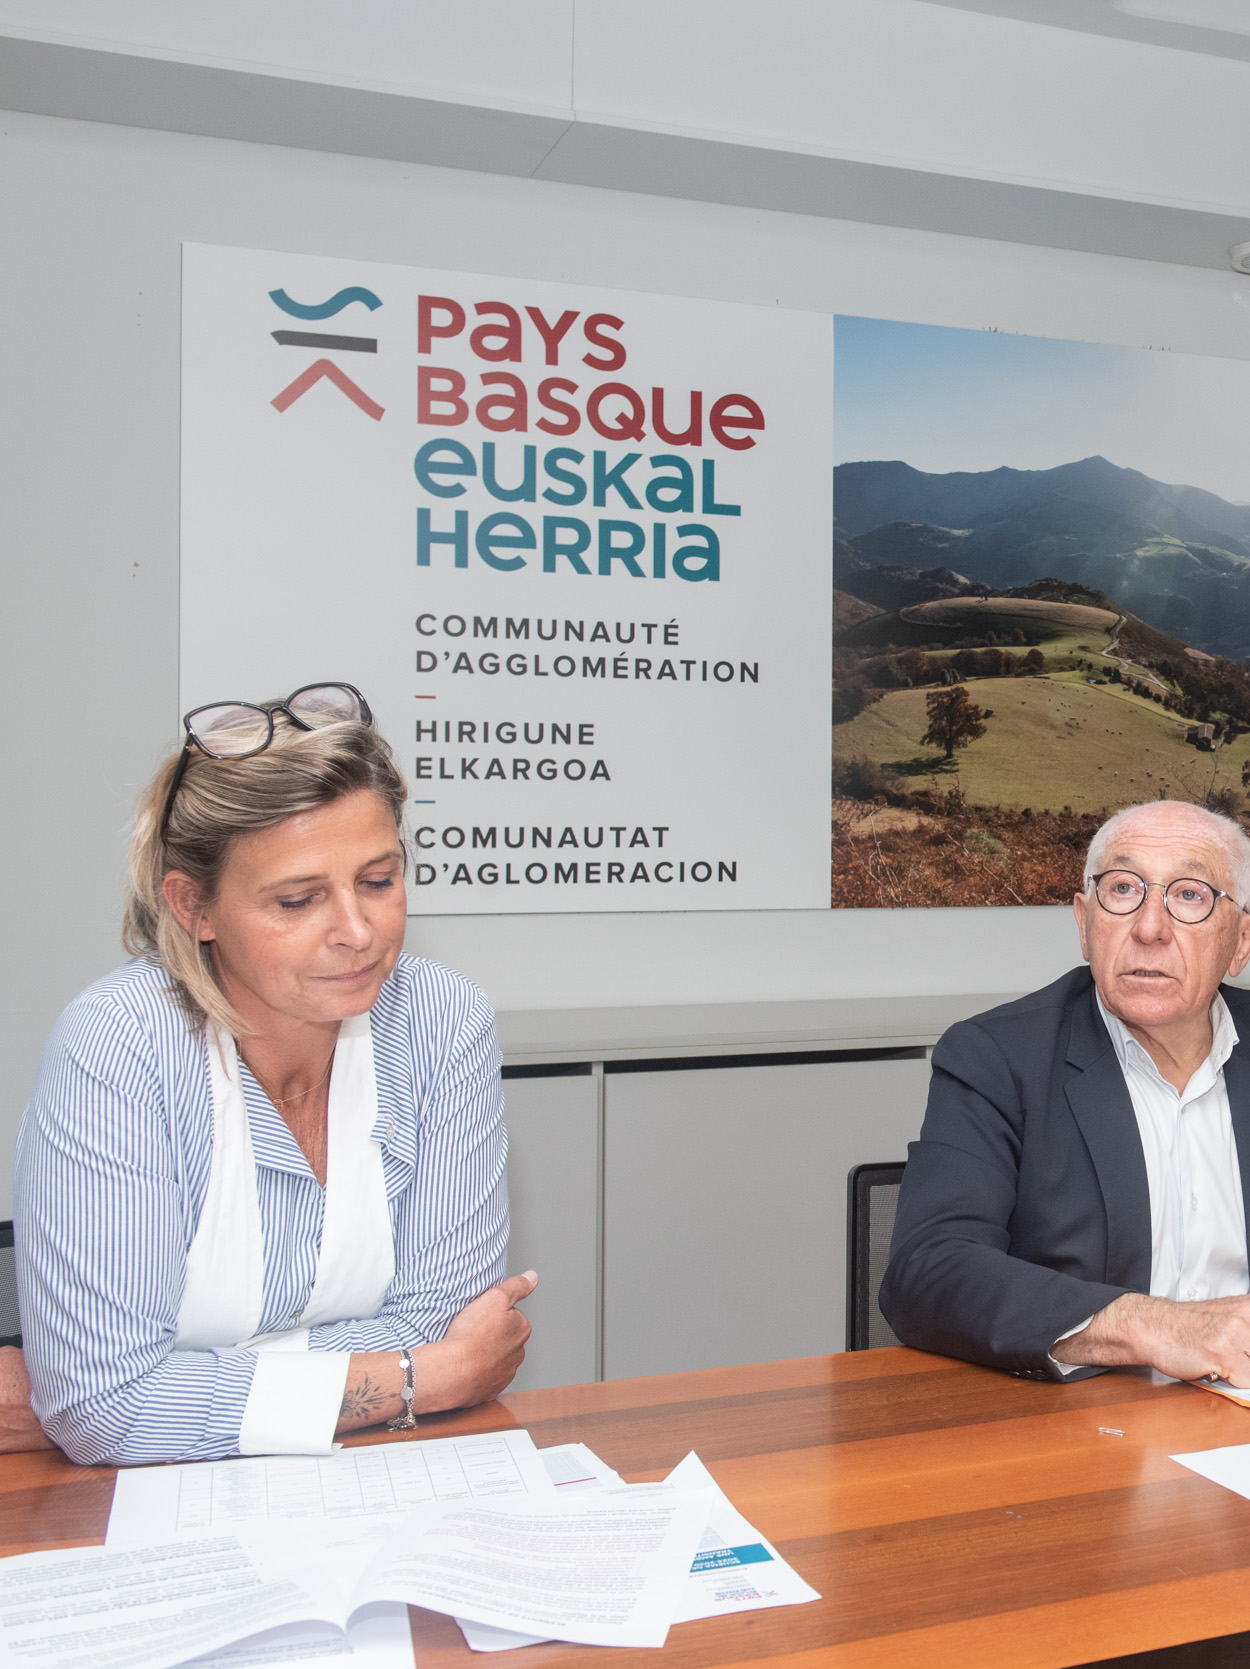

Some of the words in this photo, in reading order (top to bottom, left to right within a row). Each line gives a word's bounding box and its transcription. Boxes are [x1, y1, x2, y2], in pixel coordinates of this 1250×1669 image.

[415, 613, 680, 647] COMMUNAUTÉ
[415, 720, 595, 746] HIRIGUNE
[415, 757, 612, 782] ELKARGOA
[414, 826, 670, 849] COMUNAUTAT
